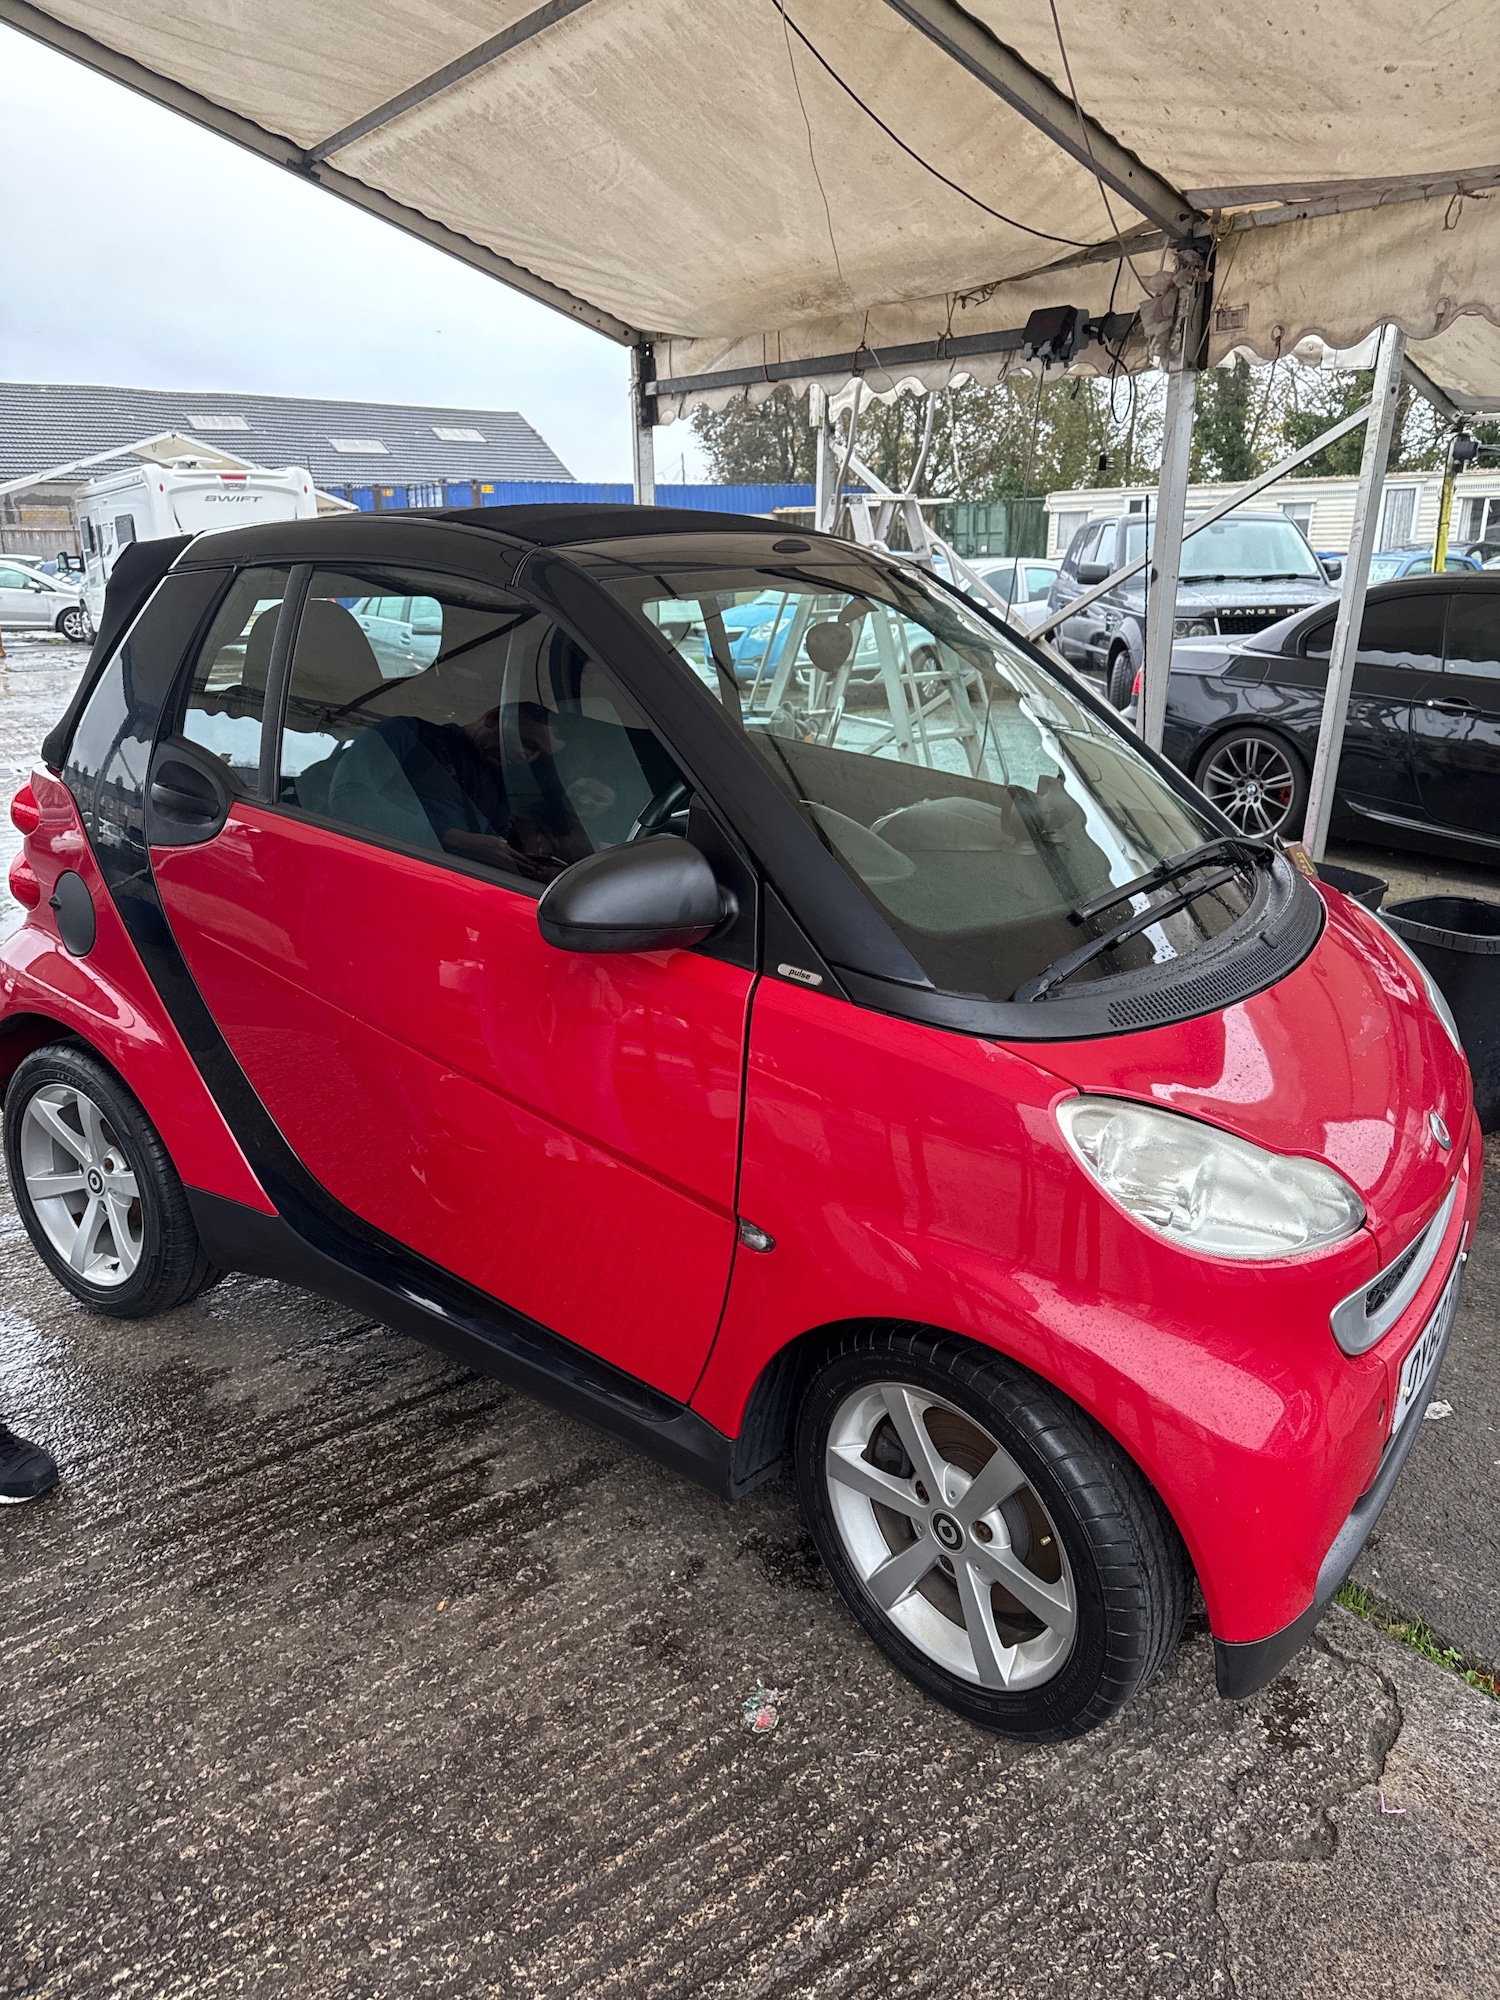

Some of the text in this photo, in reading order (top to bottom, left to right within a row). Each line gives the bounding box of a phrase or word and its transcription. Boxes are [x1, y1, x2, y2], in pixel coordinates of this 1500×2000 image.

[204, 494, 263, 502] SWIFT
[1221, 608, 1277, 616] RANGE
[788, 969, 811, 980] pulse
